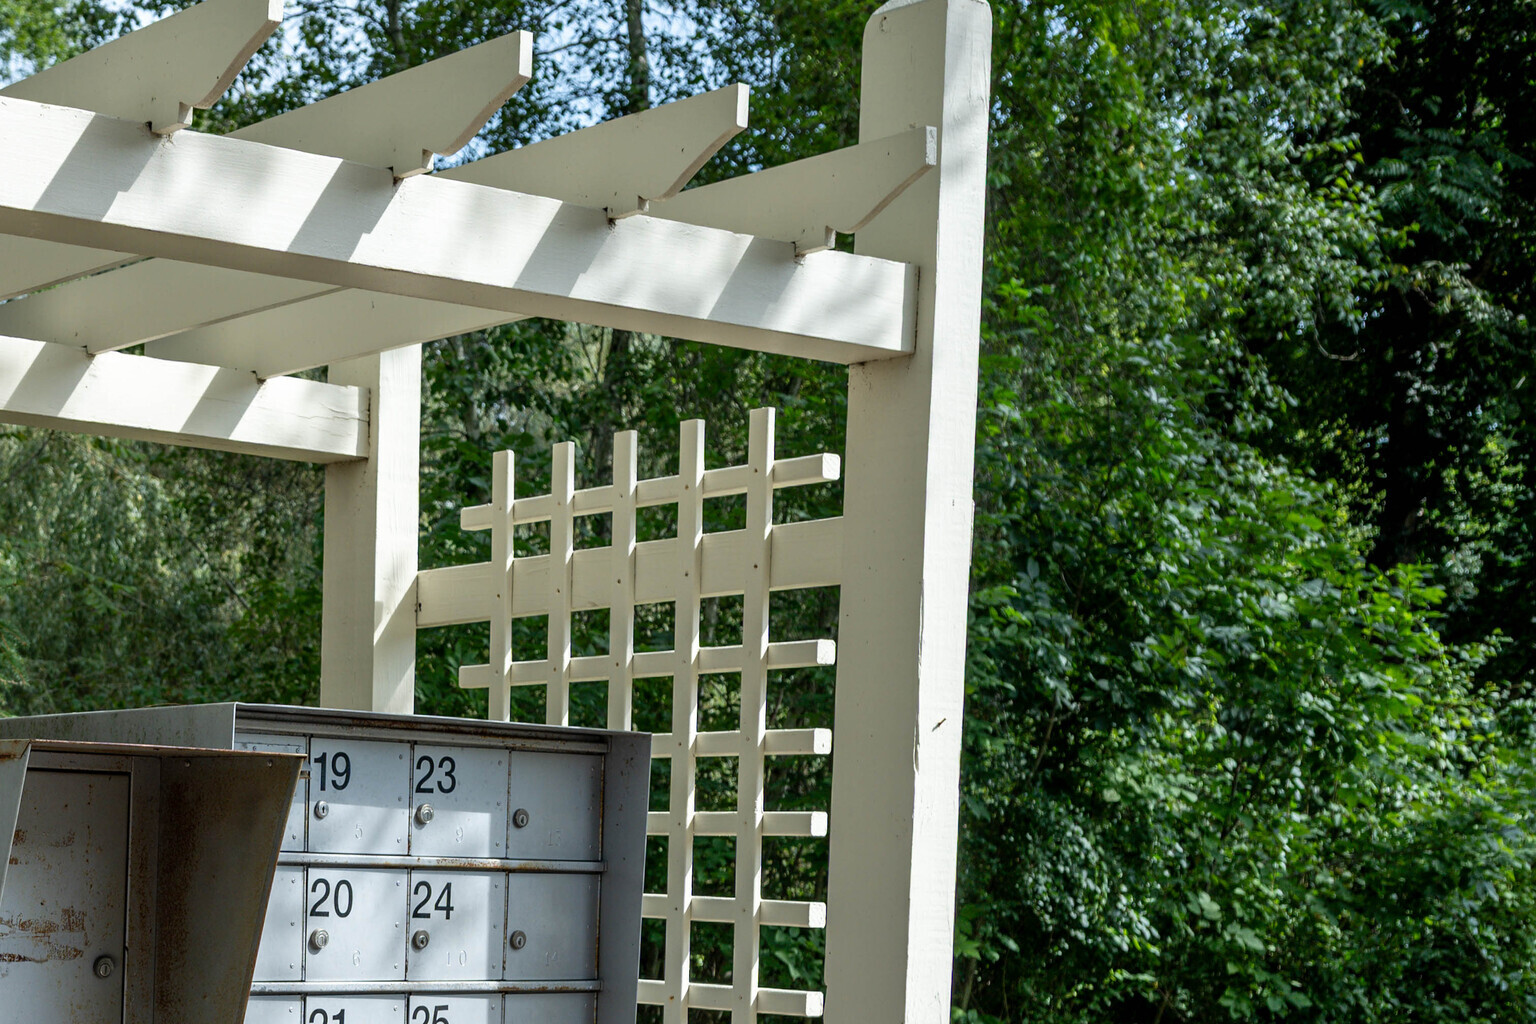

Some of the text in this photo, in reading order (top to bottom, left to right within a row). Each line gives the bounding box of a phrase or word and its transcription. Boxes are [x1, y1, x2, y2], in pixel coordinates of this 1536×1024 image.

[313, 751, 351, 792] 19
[414, 755, 457, 794] 23
[354, 823, 363, 840] 5
[455, 826, 464, 844] 9
[309, 878, 353, 918] 20
[411, 880, 455, 921] 24
[352, 950, 361, 967] 6
[445, 950, 467, 967] 10
